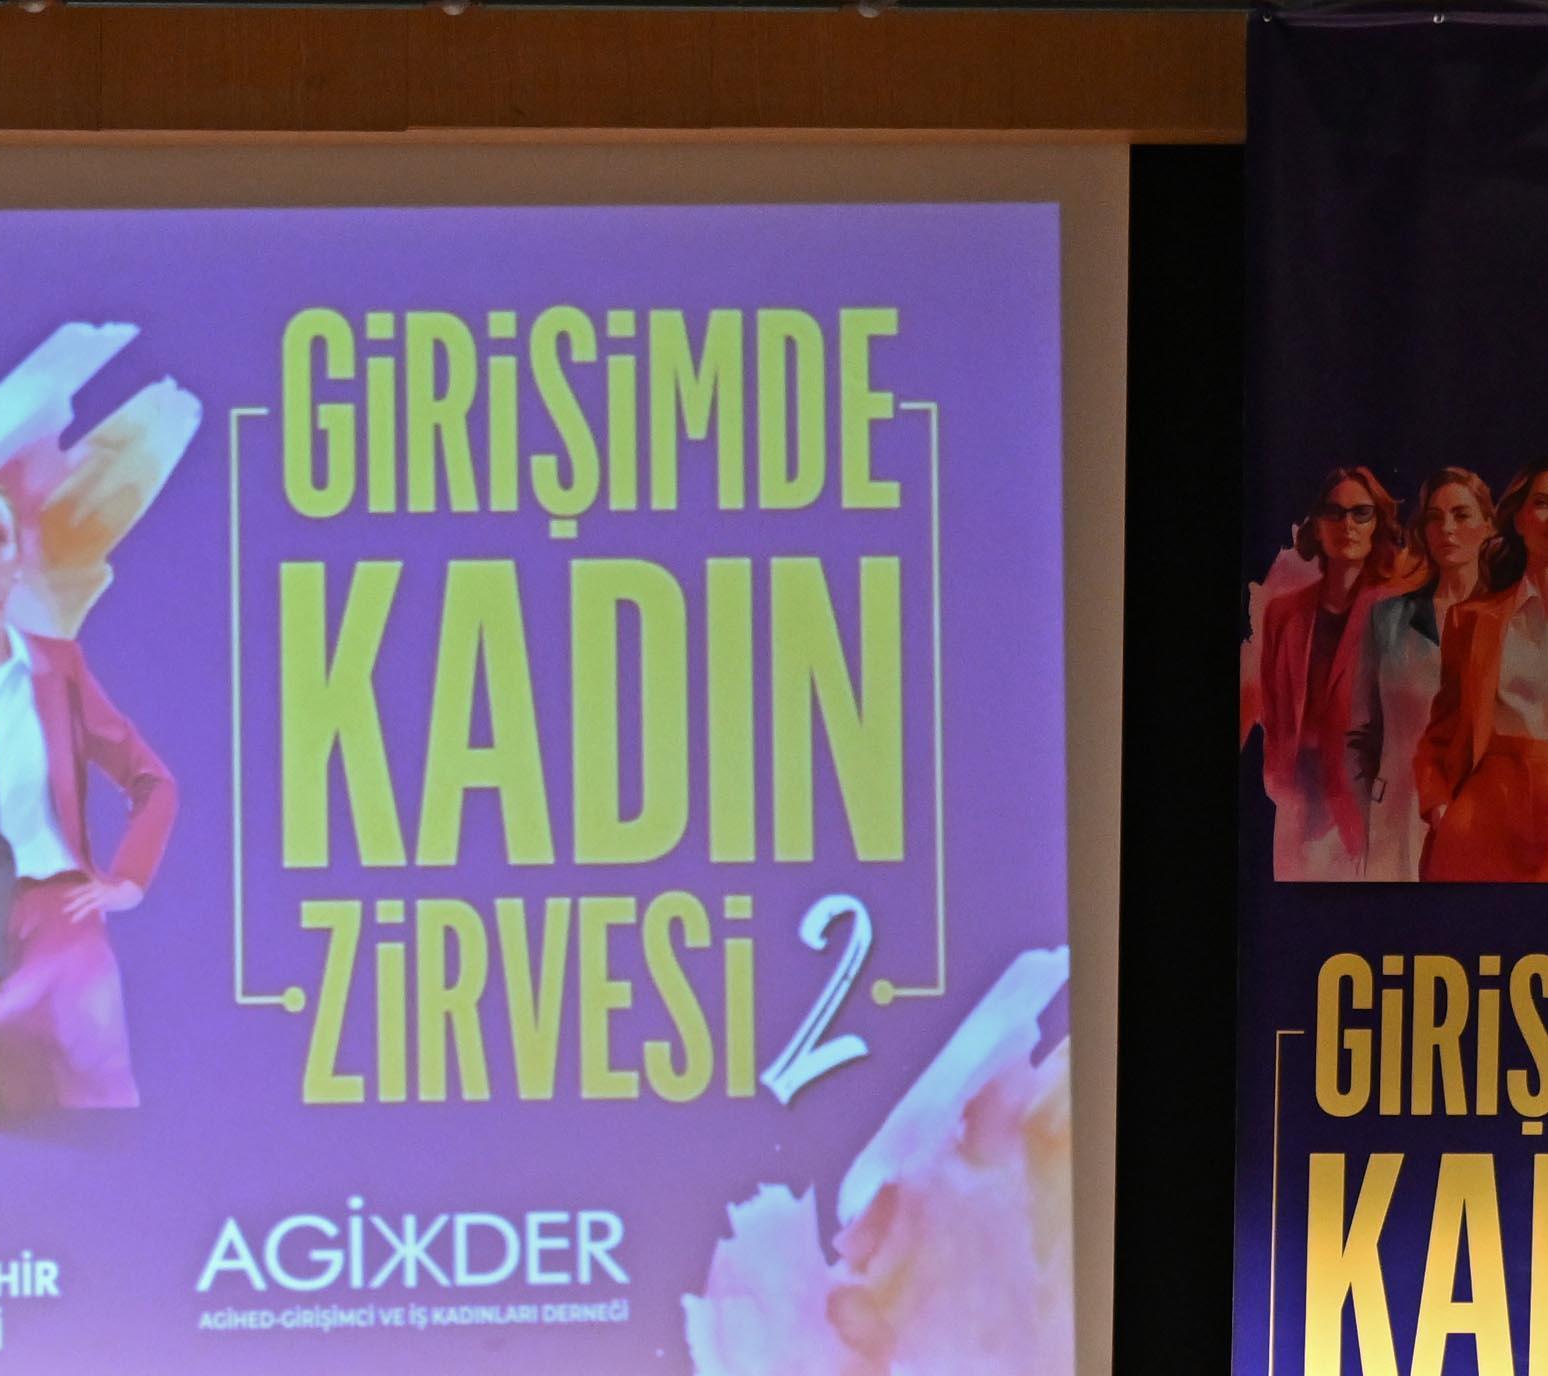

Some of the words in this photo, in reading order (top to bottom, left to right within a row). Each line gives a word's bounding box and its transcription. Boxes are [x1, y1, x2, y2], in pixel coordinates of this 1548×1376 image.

[280, 305, 901, 539] GİRİŞİMDE
[279, 556, 904, 869] KADIN
[300, 890, 756, 1105] ZİRVESİ
[761, 893, 873, 1106] 2
[381, 1307, 403, 1326] VE
[409, 1302, 428, 1329] İŞ
[432, 1305, 537, 1325] KADINLARI
[543, 1298, 630, 1322] DERNEĞİ
